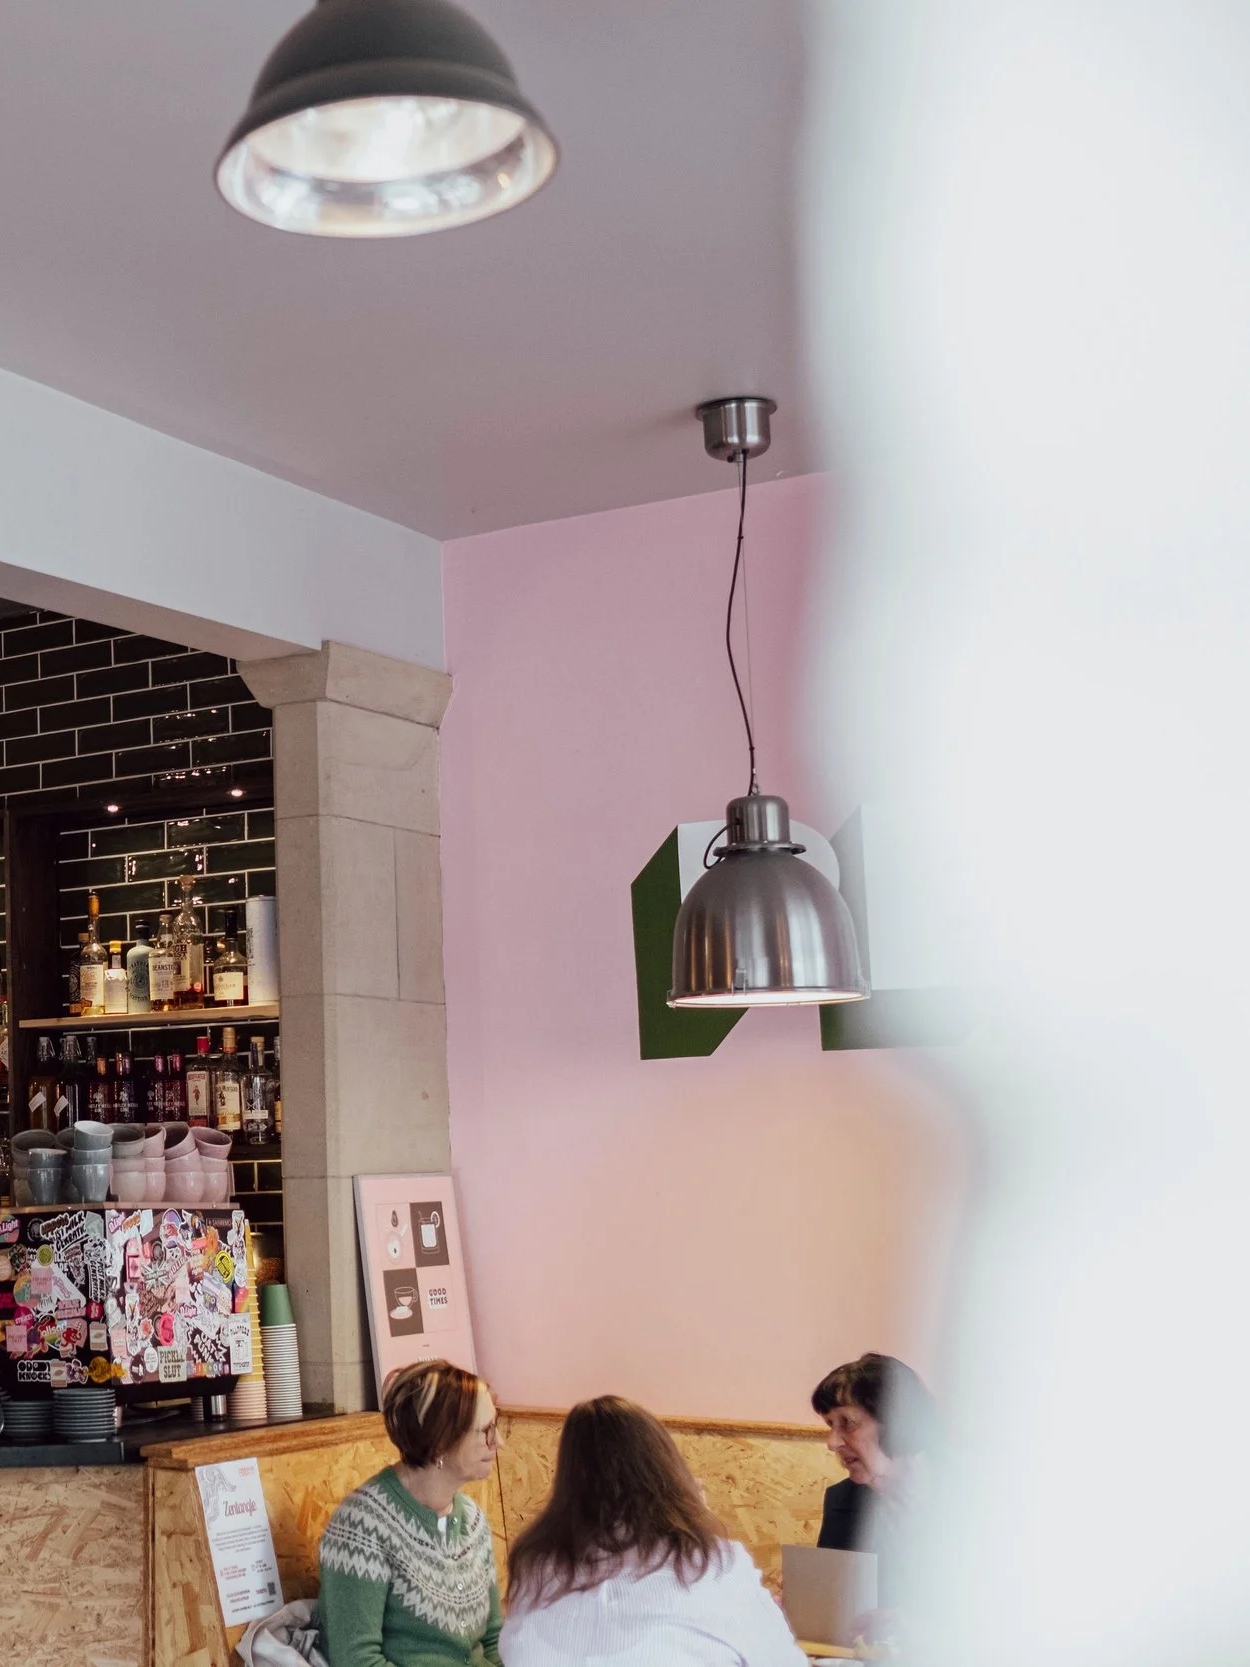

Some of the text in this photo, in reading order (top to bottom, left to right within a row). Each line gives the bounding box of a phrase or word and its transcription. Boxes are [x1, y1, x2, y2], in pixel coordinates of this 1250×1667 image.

[429, 1287, 447, 1297] GOOD
[430, 1296, 448, 1306] TIMES
[164, 1365, 181, 1378] SLUT
